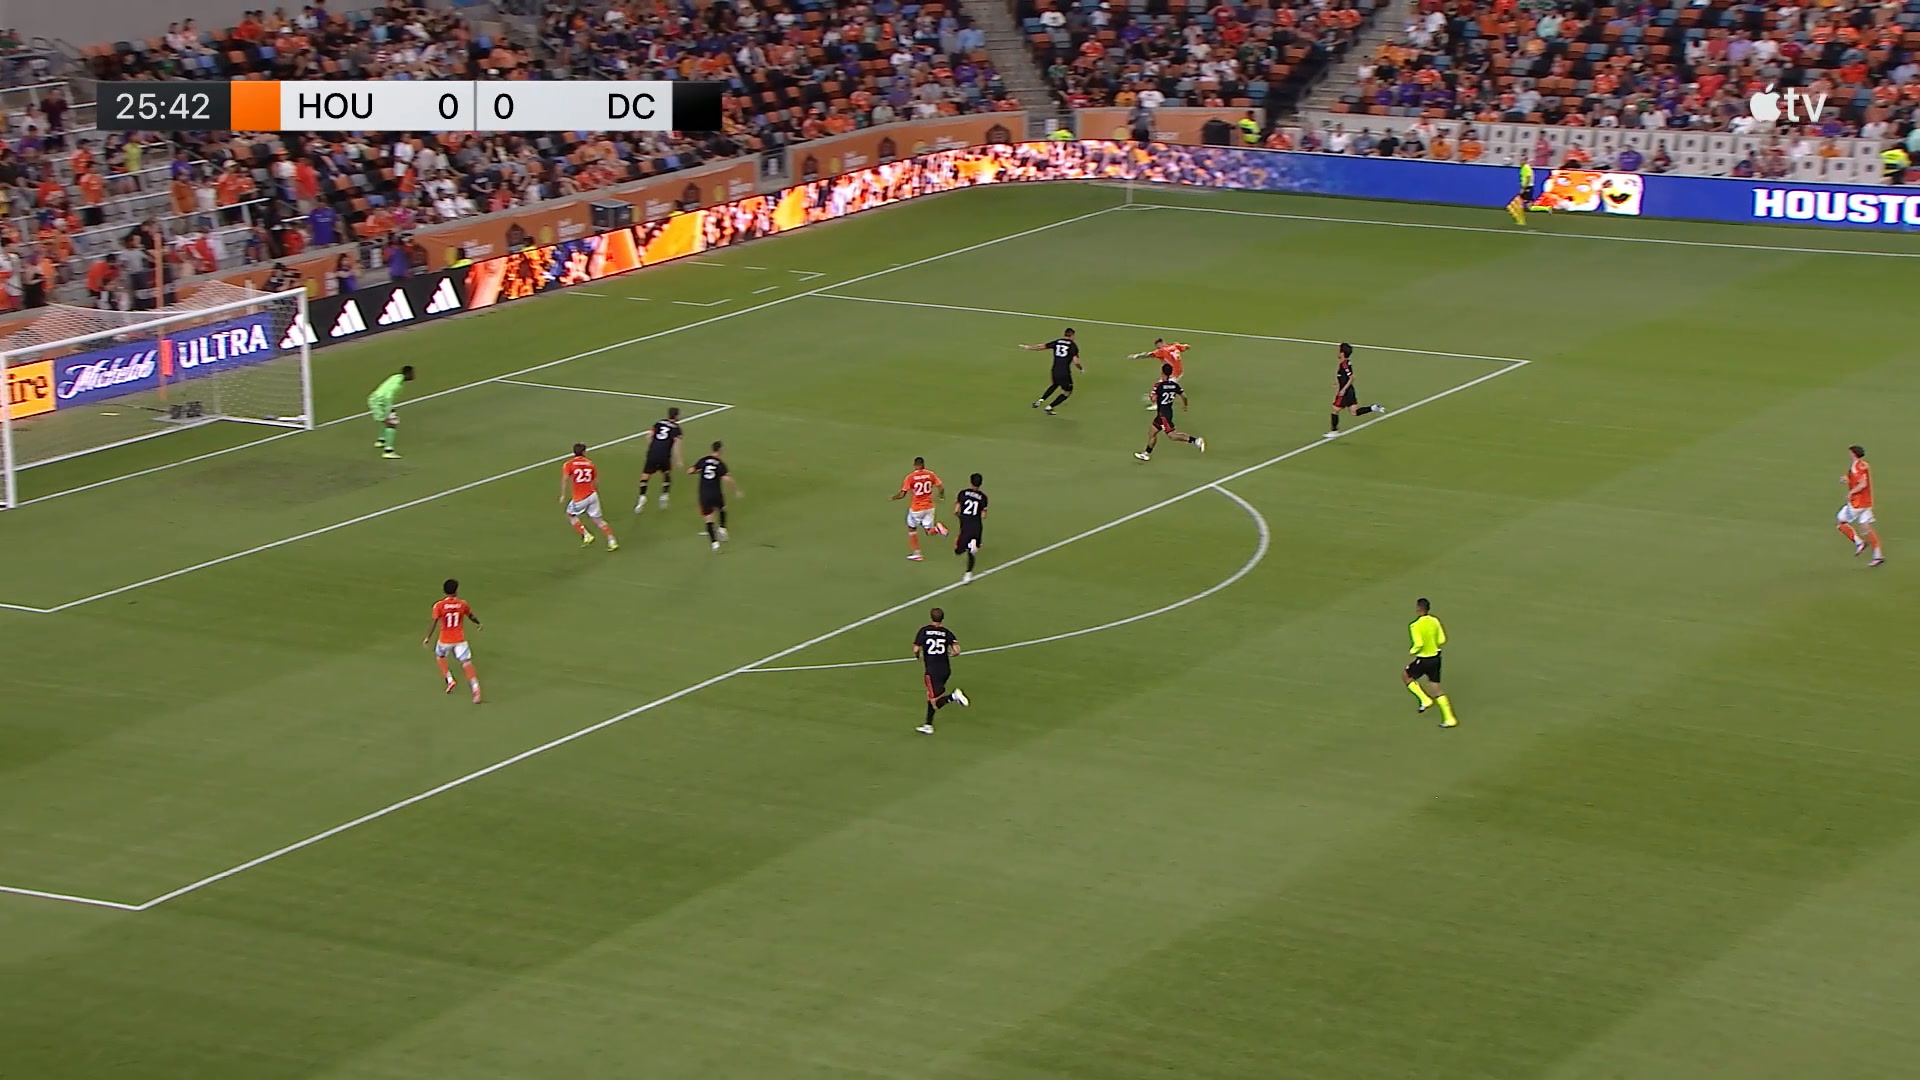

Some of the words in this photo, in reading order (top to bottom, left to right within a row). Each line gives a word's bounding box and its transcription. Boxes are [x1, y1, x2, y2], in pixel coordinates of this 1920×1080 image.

[1752, 188, 1920, 226] HOUSTO
[177, 324, 270, 369] ULTRA
[1055, 344, 1070, 358] 13
[1160, 391, 1176, 405] 23
[655, 426, 671, 440] 3
[573, 468, 593, 483] 23
[703, 464, 718, 480] 5
[913, 480, 932, 496] 20
[962, 499, 979, 516] 21
[445, 612, 460, 628] 11
[925, 638, 946, 655] 25
